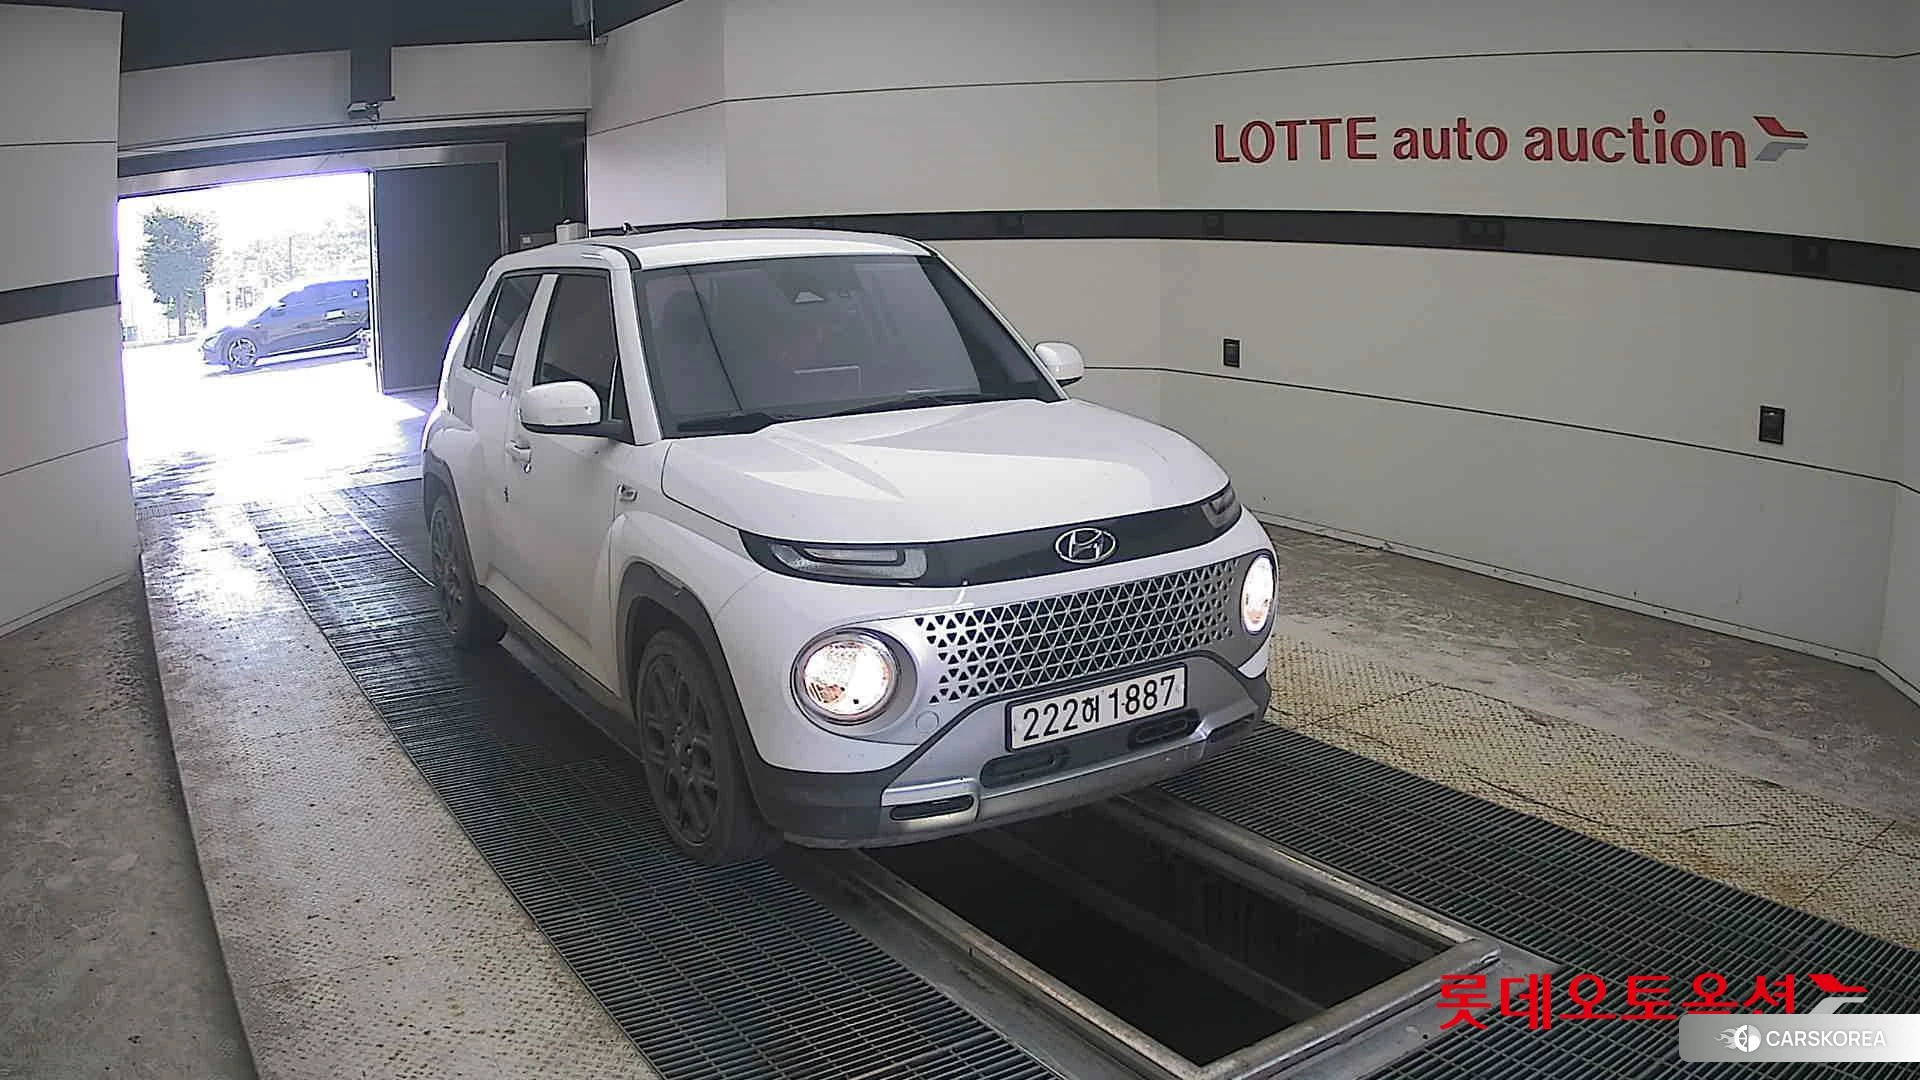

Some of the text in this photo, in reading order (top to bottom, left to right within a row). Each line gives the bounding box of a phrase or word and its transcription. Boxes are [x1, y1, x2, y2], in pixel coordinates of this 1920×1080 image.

[1214, 110, 1747, 168] LOTTE auto auction
[1109, 675, 1176, 719] 1887
